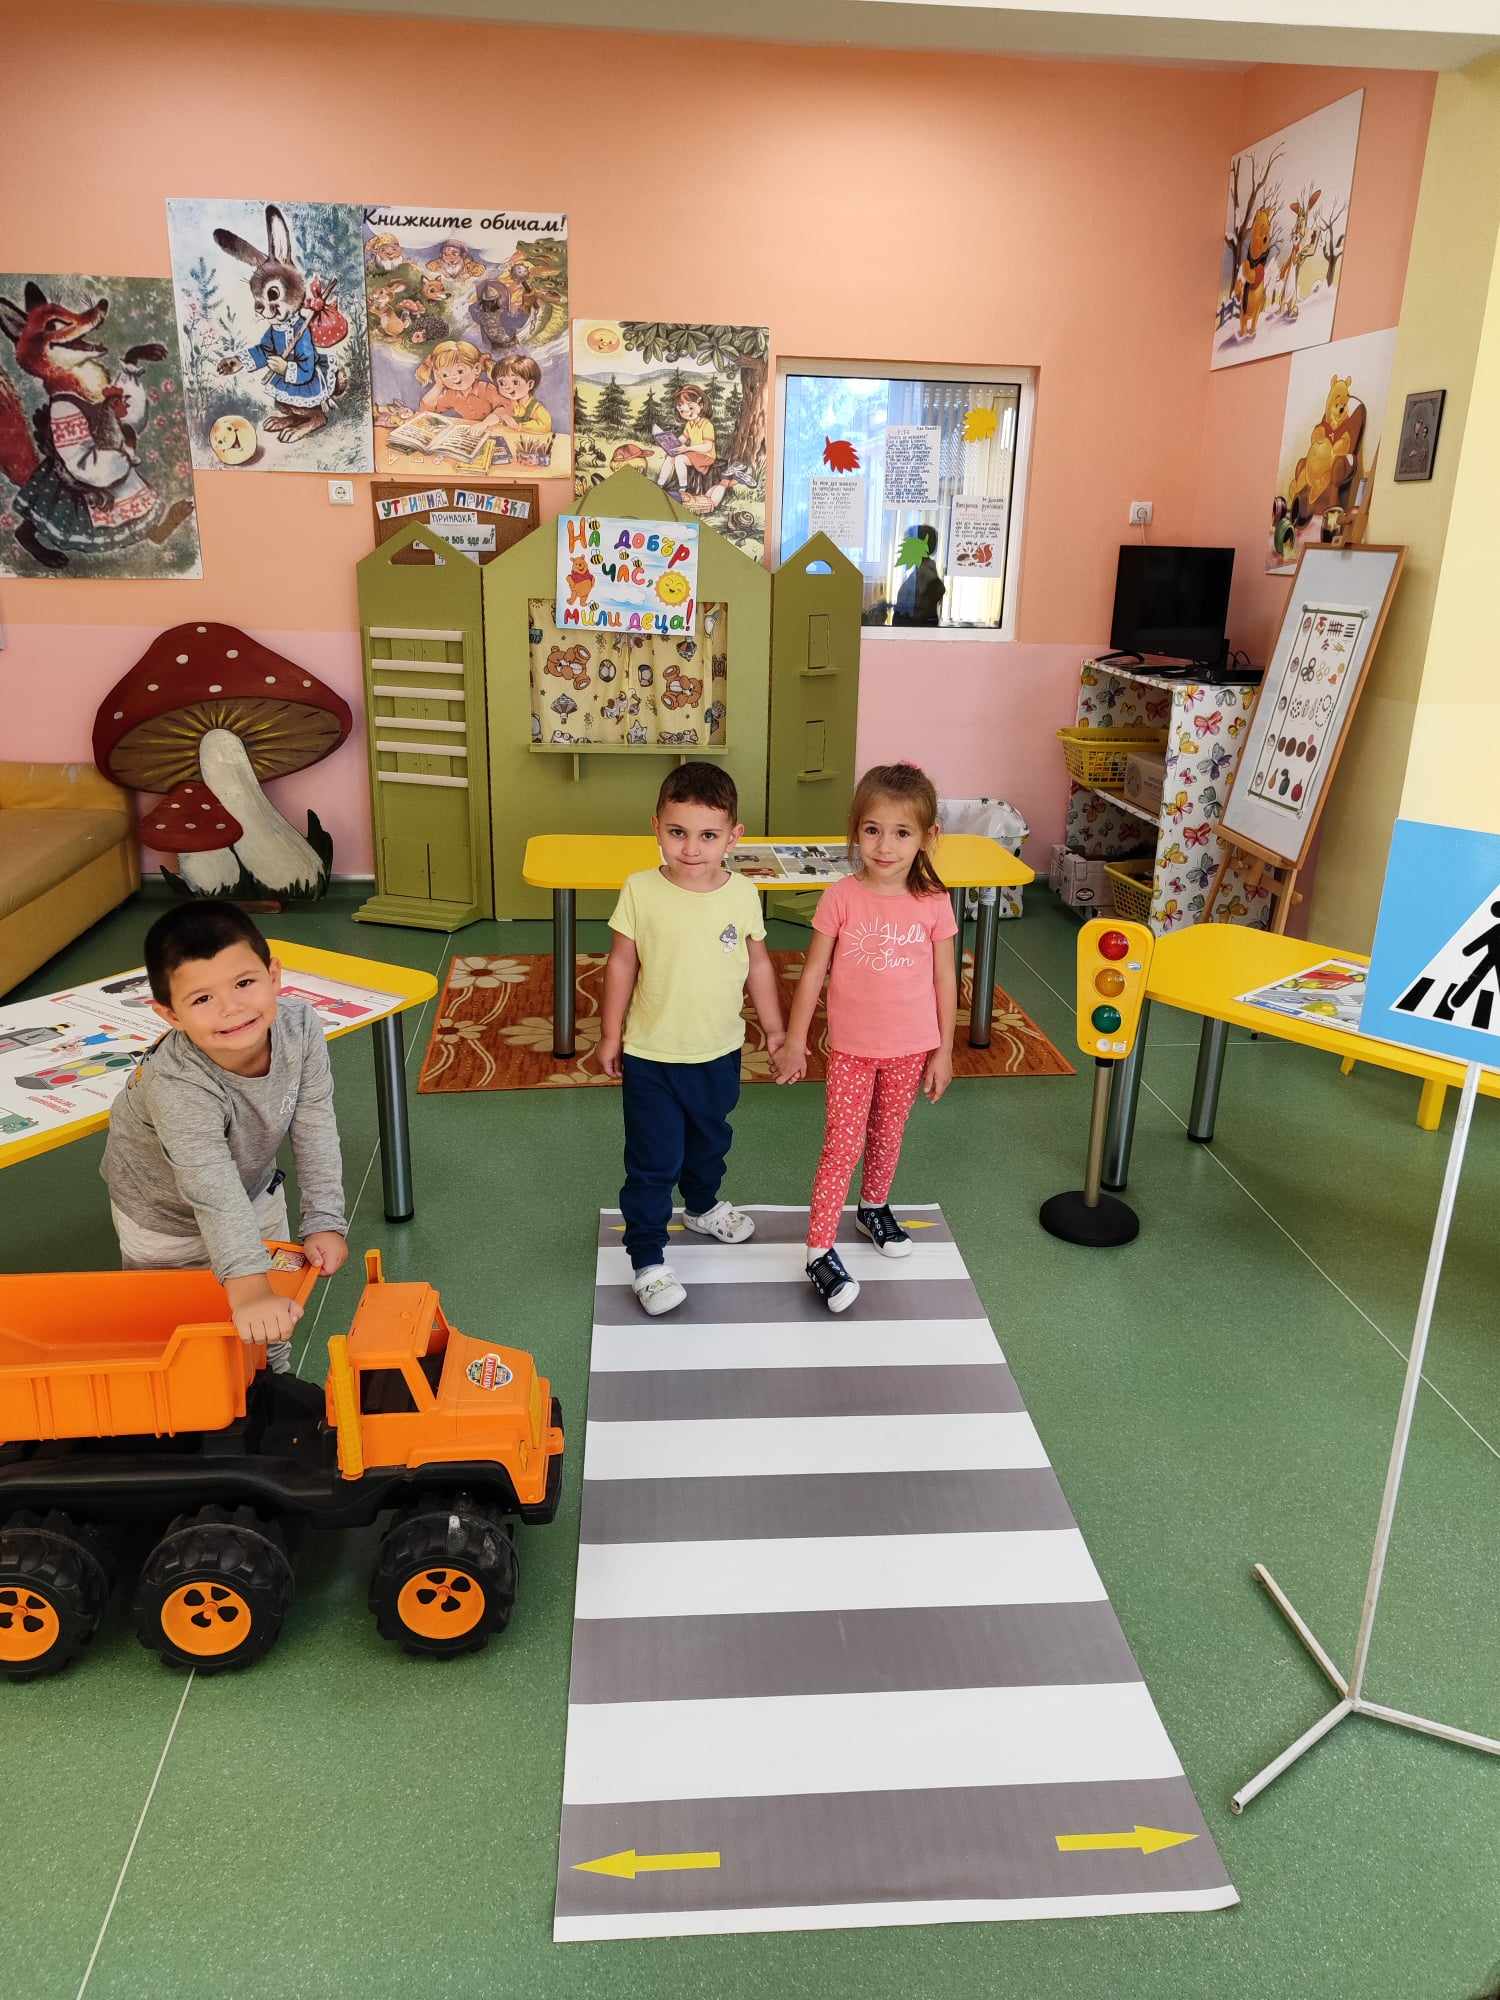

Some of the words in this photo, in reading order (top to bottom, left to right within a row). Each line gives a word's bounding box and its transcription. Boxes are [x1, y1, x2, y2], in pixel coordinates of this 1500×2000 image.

[363, 208, 472, 229] Книжките
[480, 213, 567, 232] обичам!
[380, 490, 445, 517] УТРИННА
[455, 491, 530, 518] ПРИКАЗКА
[878, 921, 926, 946] Hello
[871, 948, 914, 971] Sun
